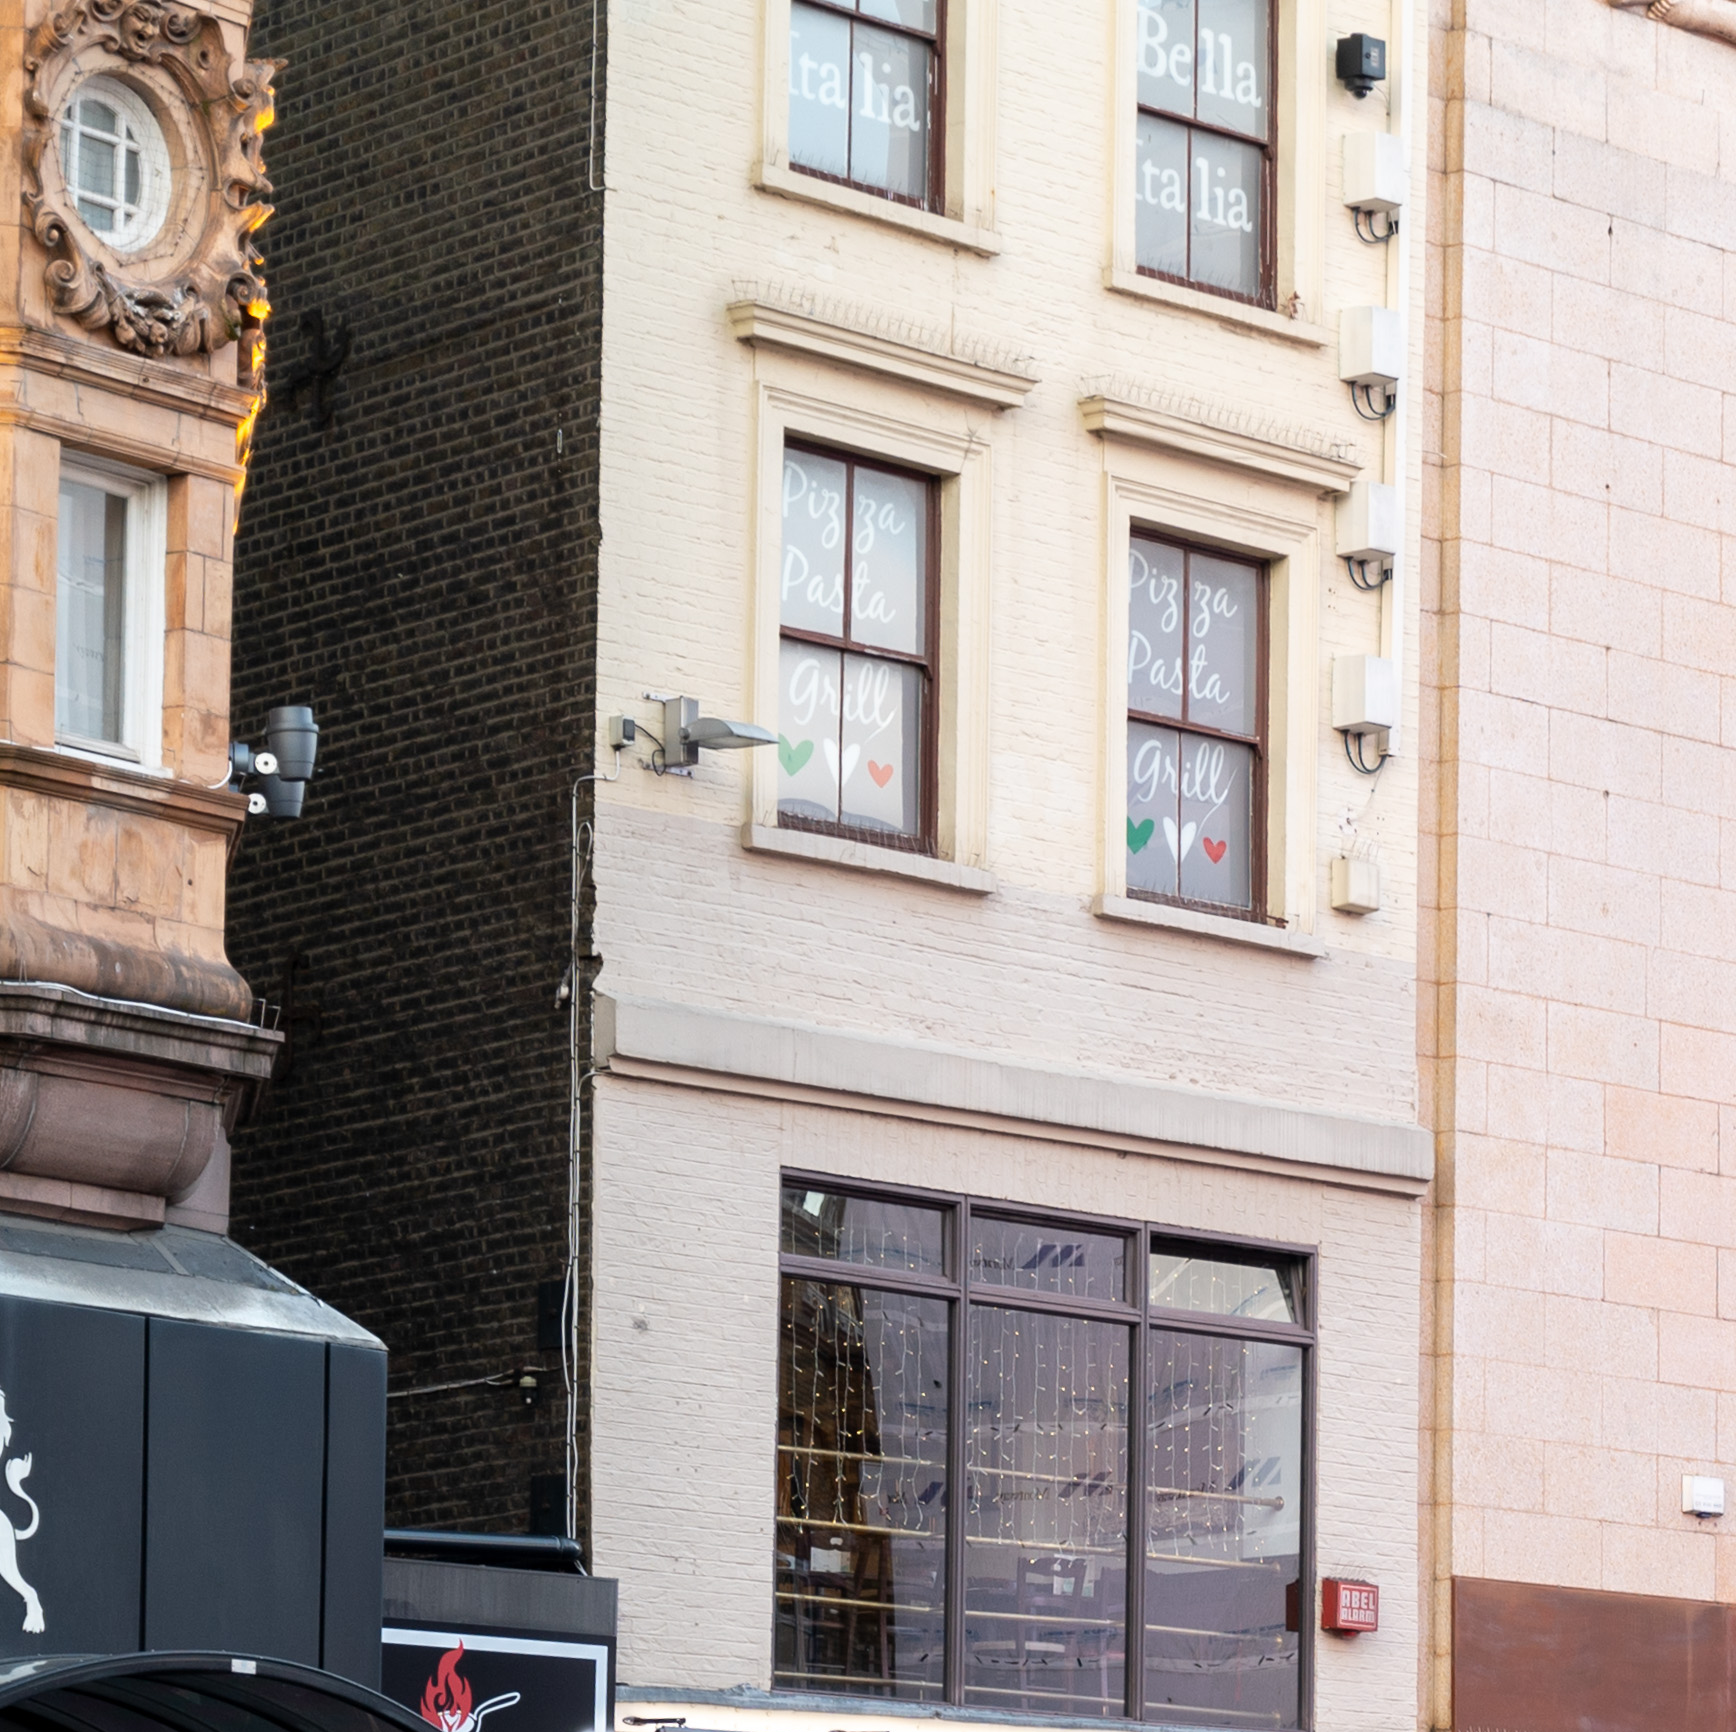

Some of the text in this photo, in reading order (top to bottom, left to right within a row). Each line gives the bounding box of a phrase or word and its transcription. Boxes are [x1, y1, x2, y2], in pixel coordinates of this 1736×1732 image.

[789, 30, 920, 132] talia
[1137, 5, 1261, 108] Bella
[1136, 138, 1252, 233] talia
[781, 460, 906, 553] Pizza
[780, 544, 896, 624] Pasta
[1129, 550, 1238, 637] Pizza
[788, 658, 899, 746] Grill
[1127, 629, 1231, 705] Pasta
[1134, 738, 1238, 830] Grill
[1341, 1590, 1375, 1610] ABEL
[1341, 1608, 1375, 1623] ALARM
